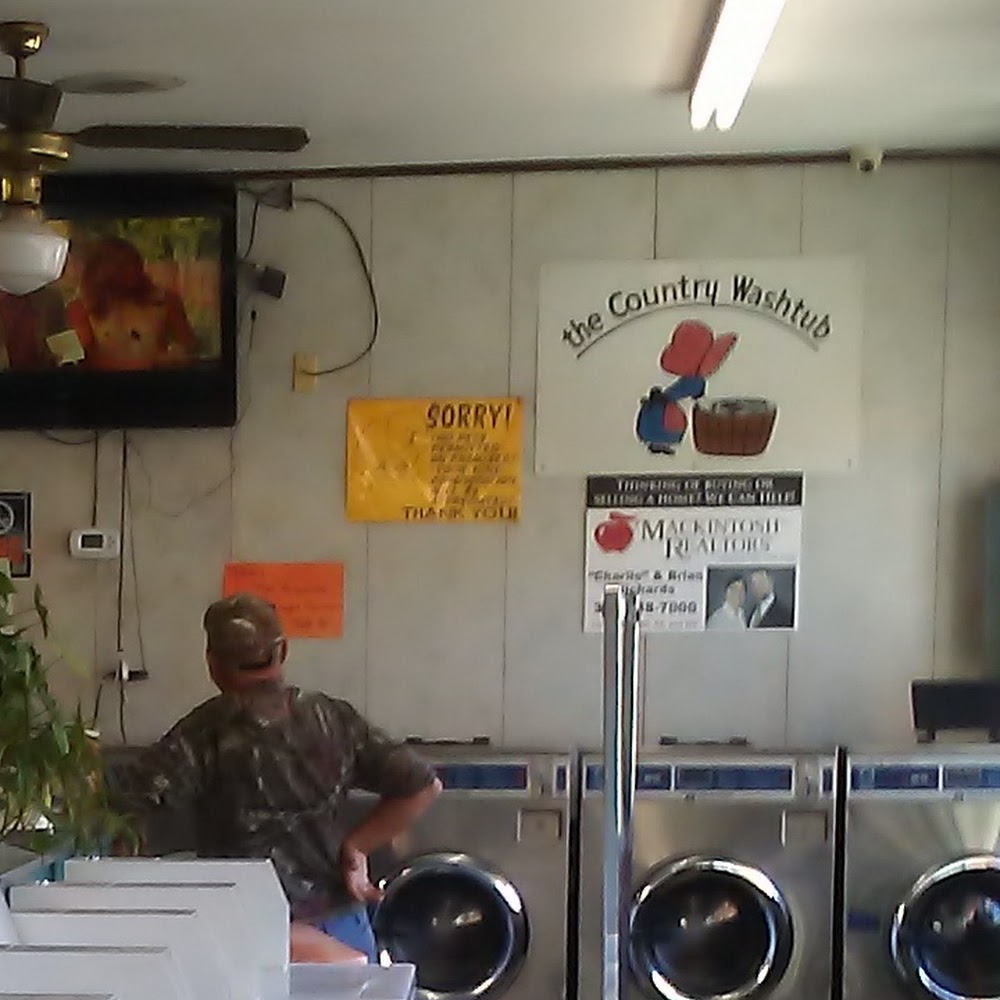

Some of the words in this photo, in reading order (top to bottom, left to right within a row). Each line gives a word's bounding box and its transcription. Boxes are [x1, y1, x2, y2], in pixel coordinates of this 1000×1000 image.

[563, 312, 604, 347] the
[608, 275, 720, 318] Country
[731, 274, 832, 339] Washtub
[427, 403, 512, 429] SORRY!
[641, 518, 780, 541] MACKINTOSH
[665, 537, 770, 559] REALTORS
